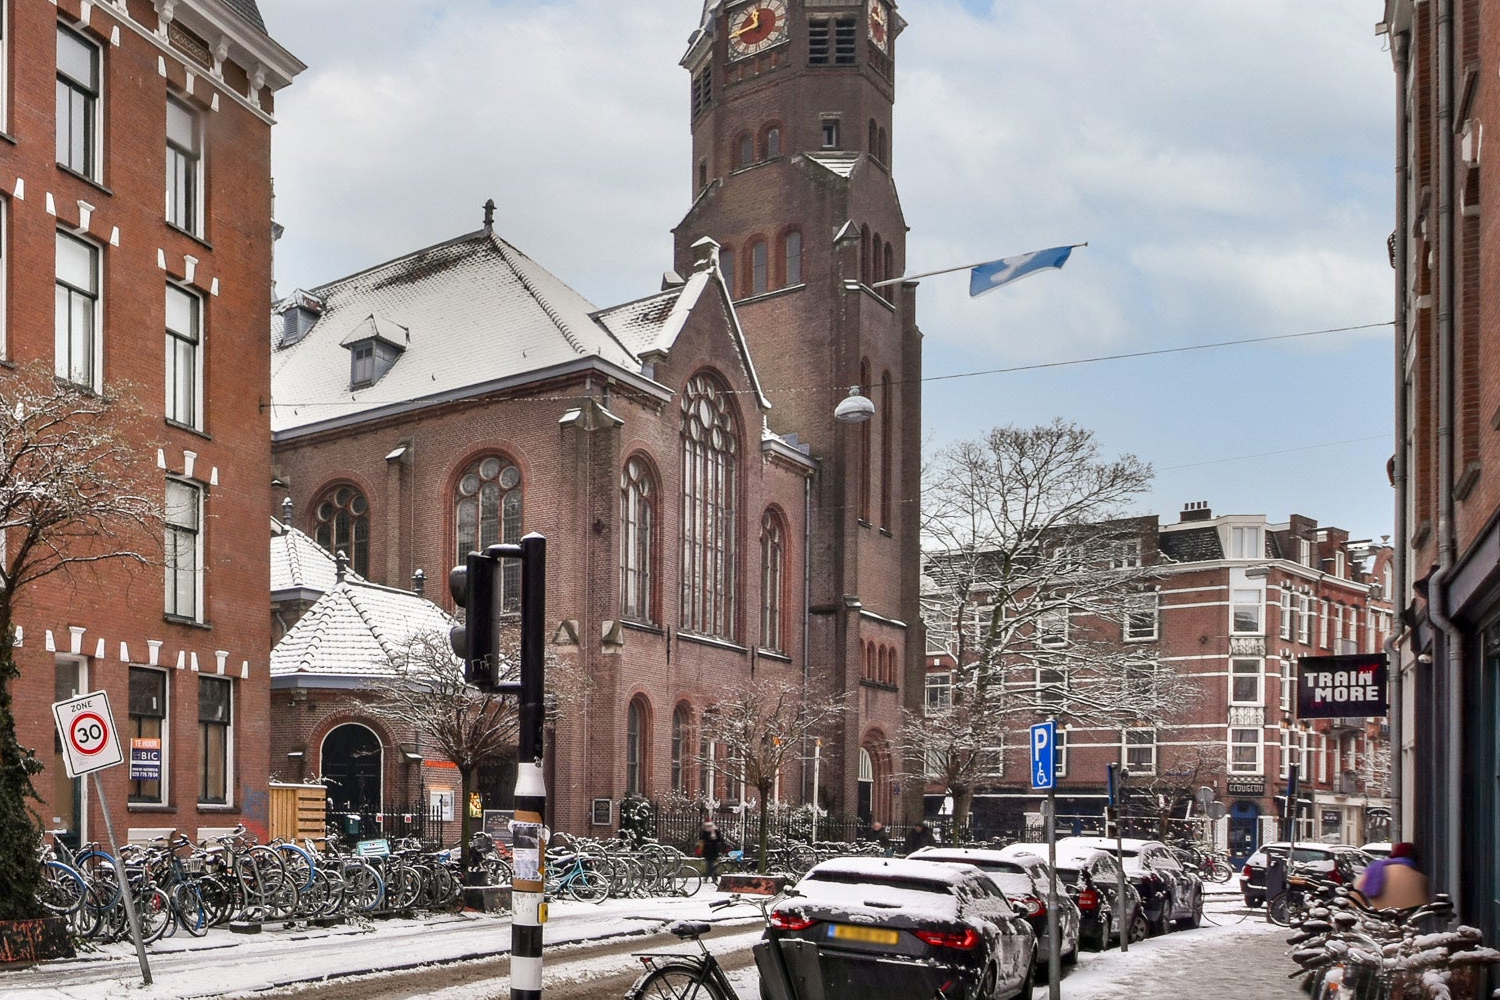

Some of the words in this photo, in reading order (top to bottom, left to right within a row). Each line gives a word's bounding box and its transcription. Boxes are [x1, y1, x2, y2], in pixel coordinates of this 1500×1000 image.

[1304, 671, 1373, 688] TRAIN
[1315, 686, 1379, 703] MORE
[71, 701, 93, 713] ZONE
[77, 724, 101, 744] 30
[1034, 728, 1048, 761] P
[141, 752, 158, 760] BIC
